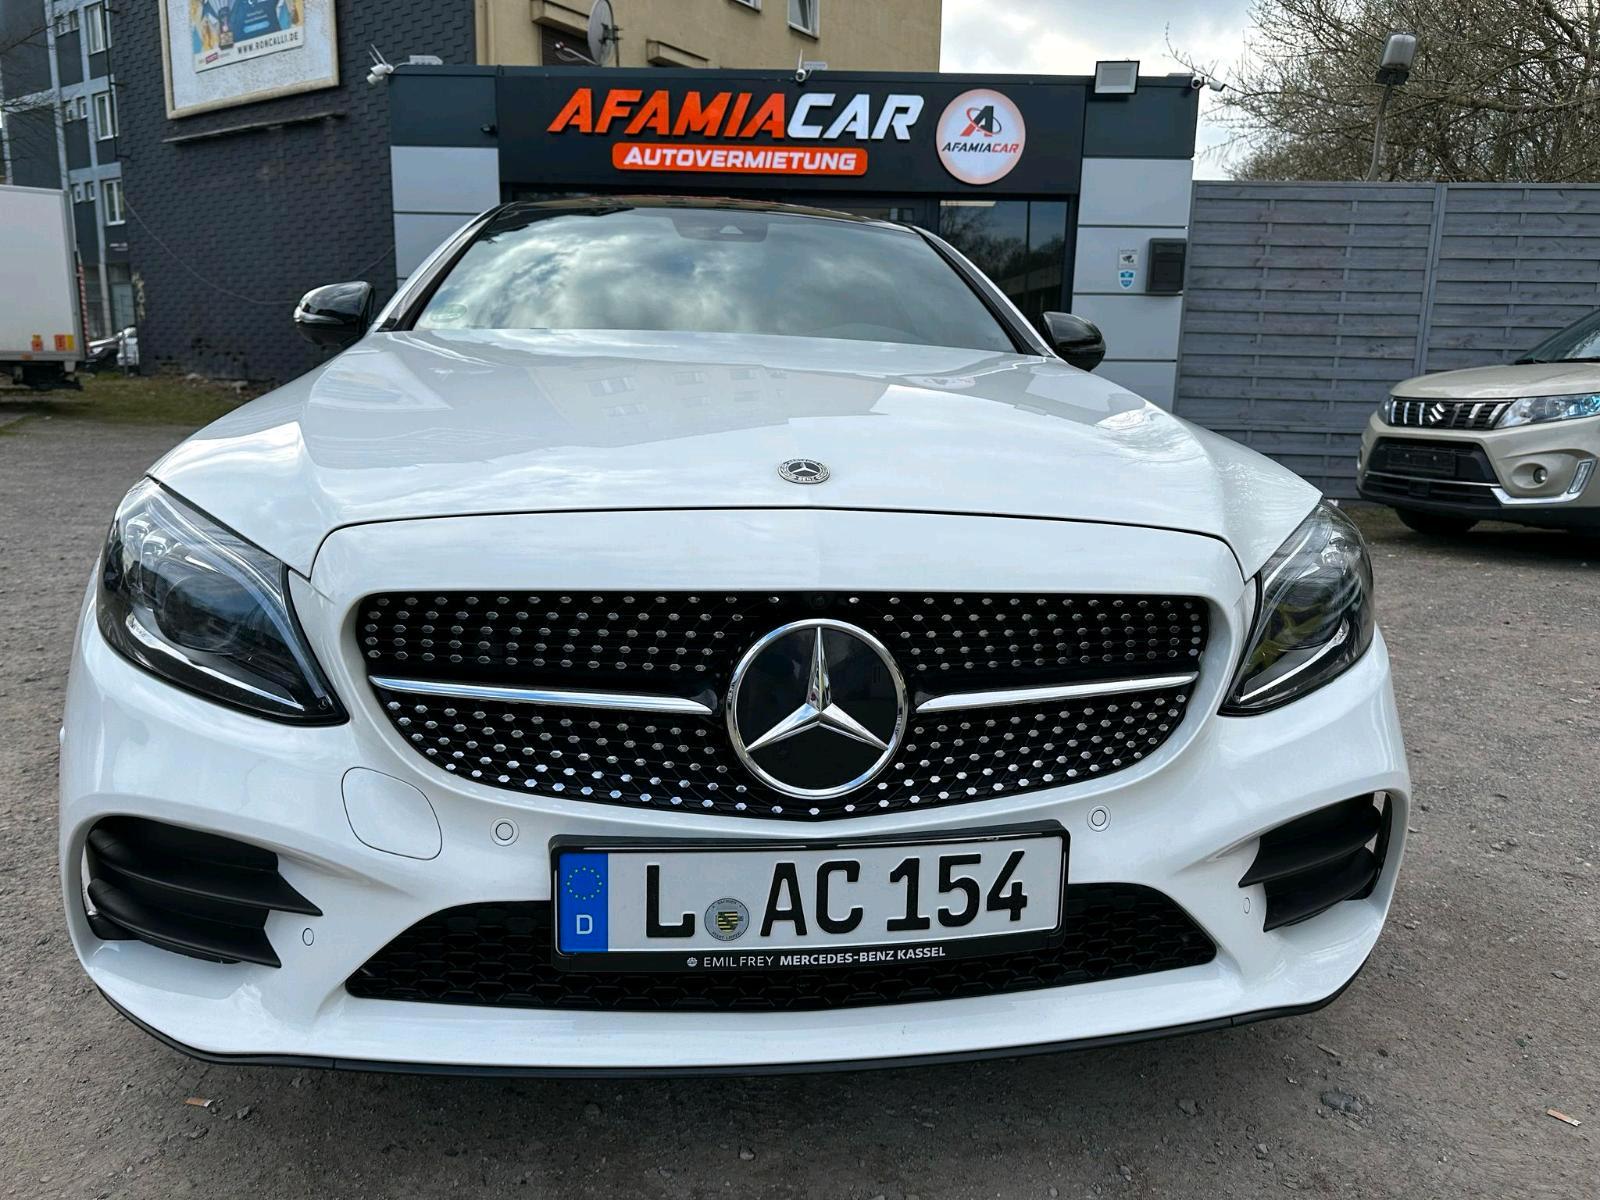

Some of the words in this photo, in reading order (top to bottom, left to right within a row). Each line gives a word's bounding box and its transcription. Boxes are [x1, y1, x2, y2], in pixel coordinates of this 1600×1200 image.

[237, 31, 299, 55] WWW.RONCALLI.DE
[546, 87, 925, 140] AFAMIACAR
[623, 146, 857, 171] AUTOVERMIETUNG
[942, 142, 1020, 153] AFAMIACAR
[646, 864, 696, 938] L
[760, 860, 864, 935] AC
[886, 850, 1029, 932] 154
[576, 914, 593, 935] D
[779, 951, 894, 966] MERCEDES-BENZ
[897, 946, 946, 960] KASSEL
